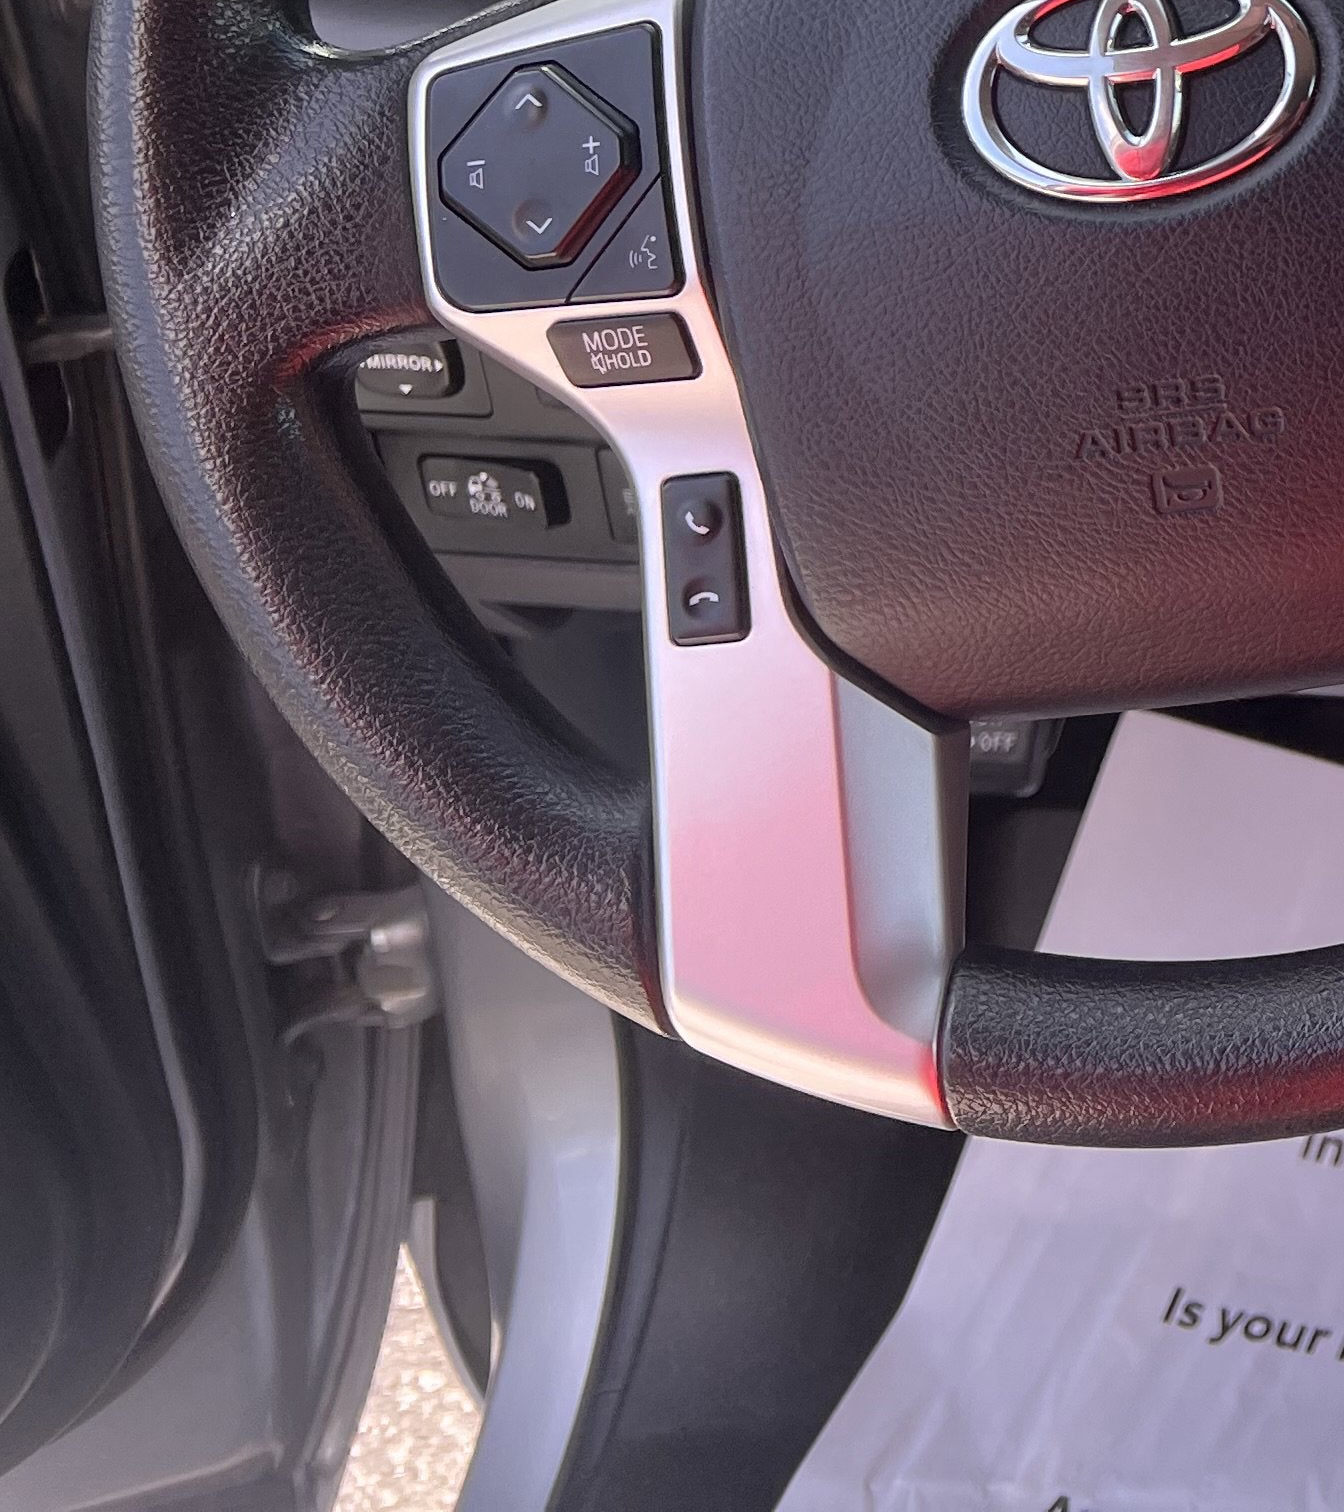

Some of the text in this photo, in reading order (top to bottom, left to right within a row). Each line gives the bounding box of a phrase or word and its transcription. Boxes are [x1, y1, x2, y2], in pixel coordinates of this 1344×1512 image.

[582, 325, 649, 354] MODE
[367, 354, 433, 372] MIRROR
[607, 350, 652, 370] HOLD
[1116, 374, 1227, 412] SRS
[1076, 406, 1286, 460] AIRBAG
[429, 480, 457, 497] OFF
[470, 497, 508, 519] DOOR
[514, 491, 536, 511] ON
[1162, 1287, 1204, 1331] Is
[1210, 1301, 1330, 1361] your
